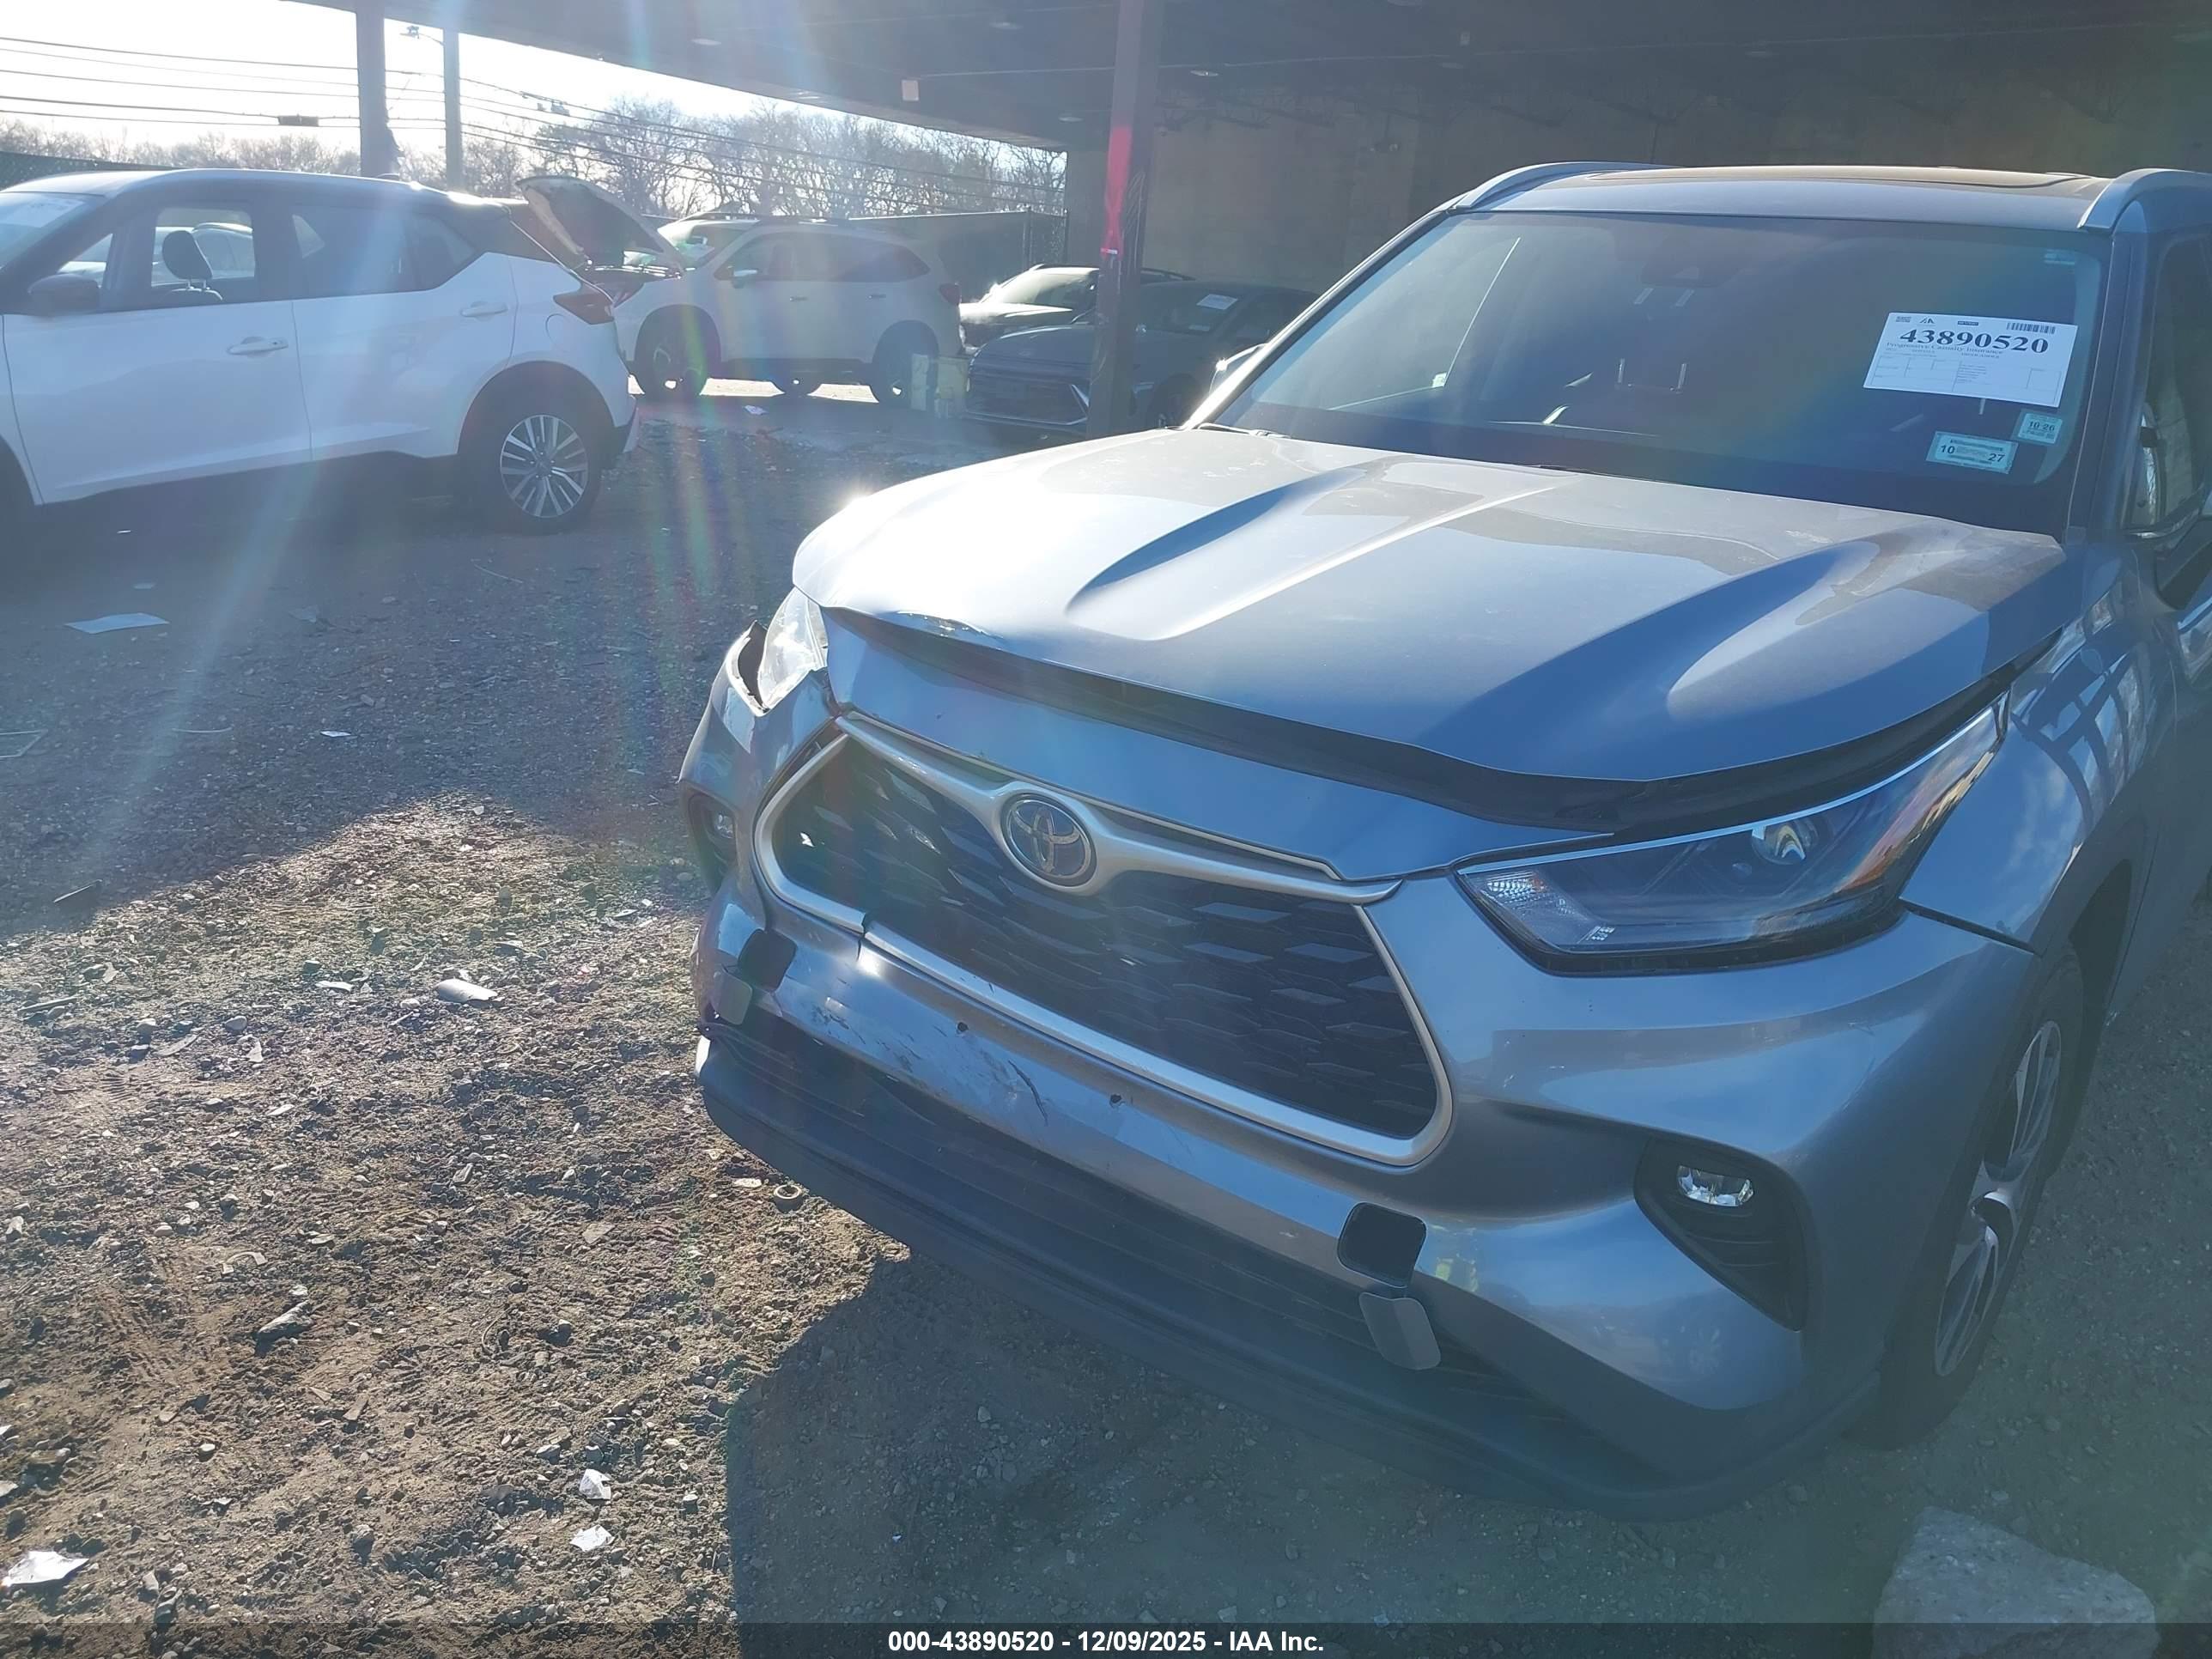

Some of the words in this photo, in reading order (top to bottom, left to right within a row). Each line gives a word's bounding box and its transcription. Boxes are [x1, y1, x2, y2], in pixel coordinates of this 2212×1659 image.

[1899, 329, 2049, 354] 43890520
[1940, 444, 1955, 454] 10
[1988, 453, 2006, 463] 27
